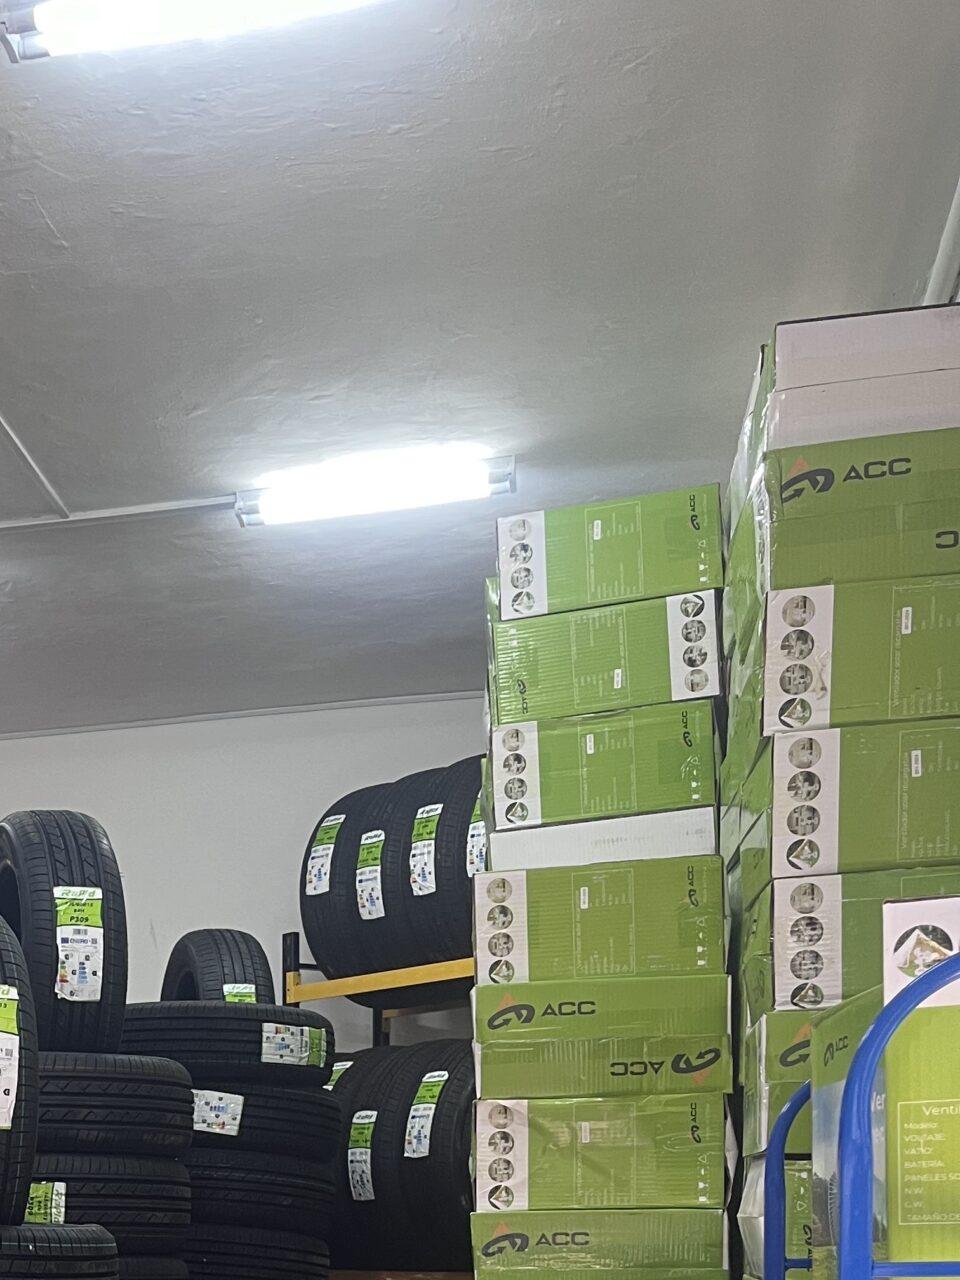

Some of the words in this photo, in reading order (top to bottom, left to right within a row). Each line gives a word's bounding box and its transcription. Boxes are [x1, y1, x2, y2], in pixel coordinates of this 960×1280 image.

[843, 457, 912, 482] ACC
[686, 865, 694, 887] ACC
[541, 1001, 596, 1017] ACC
[609, 1060, 665, 1076] ACC
[690, 1102, 698, 1124] ACC
[535, 1232, 590, 1247] ACC
